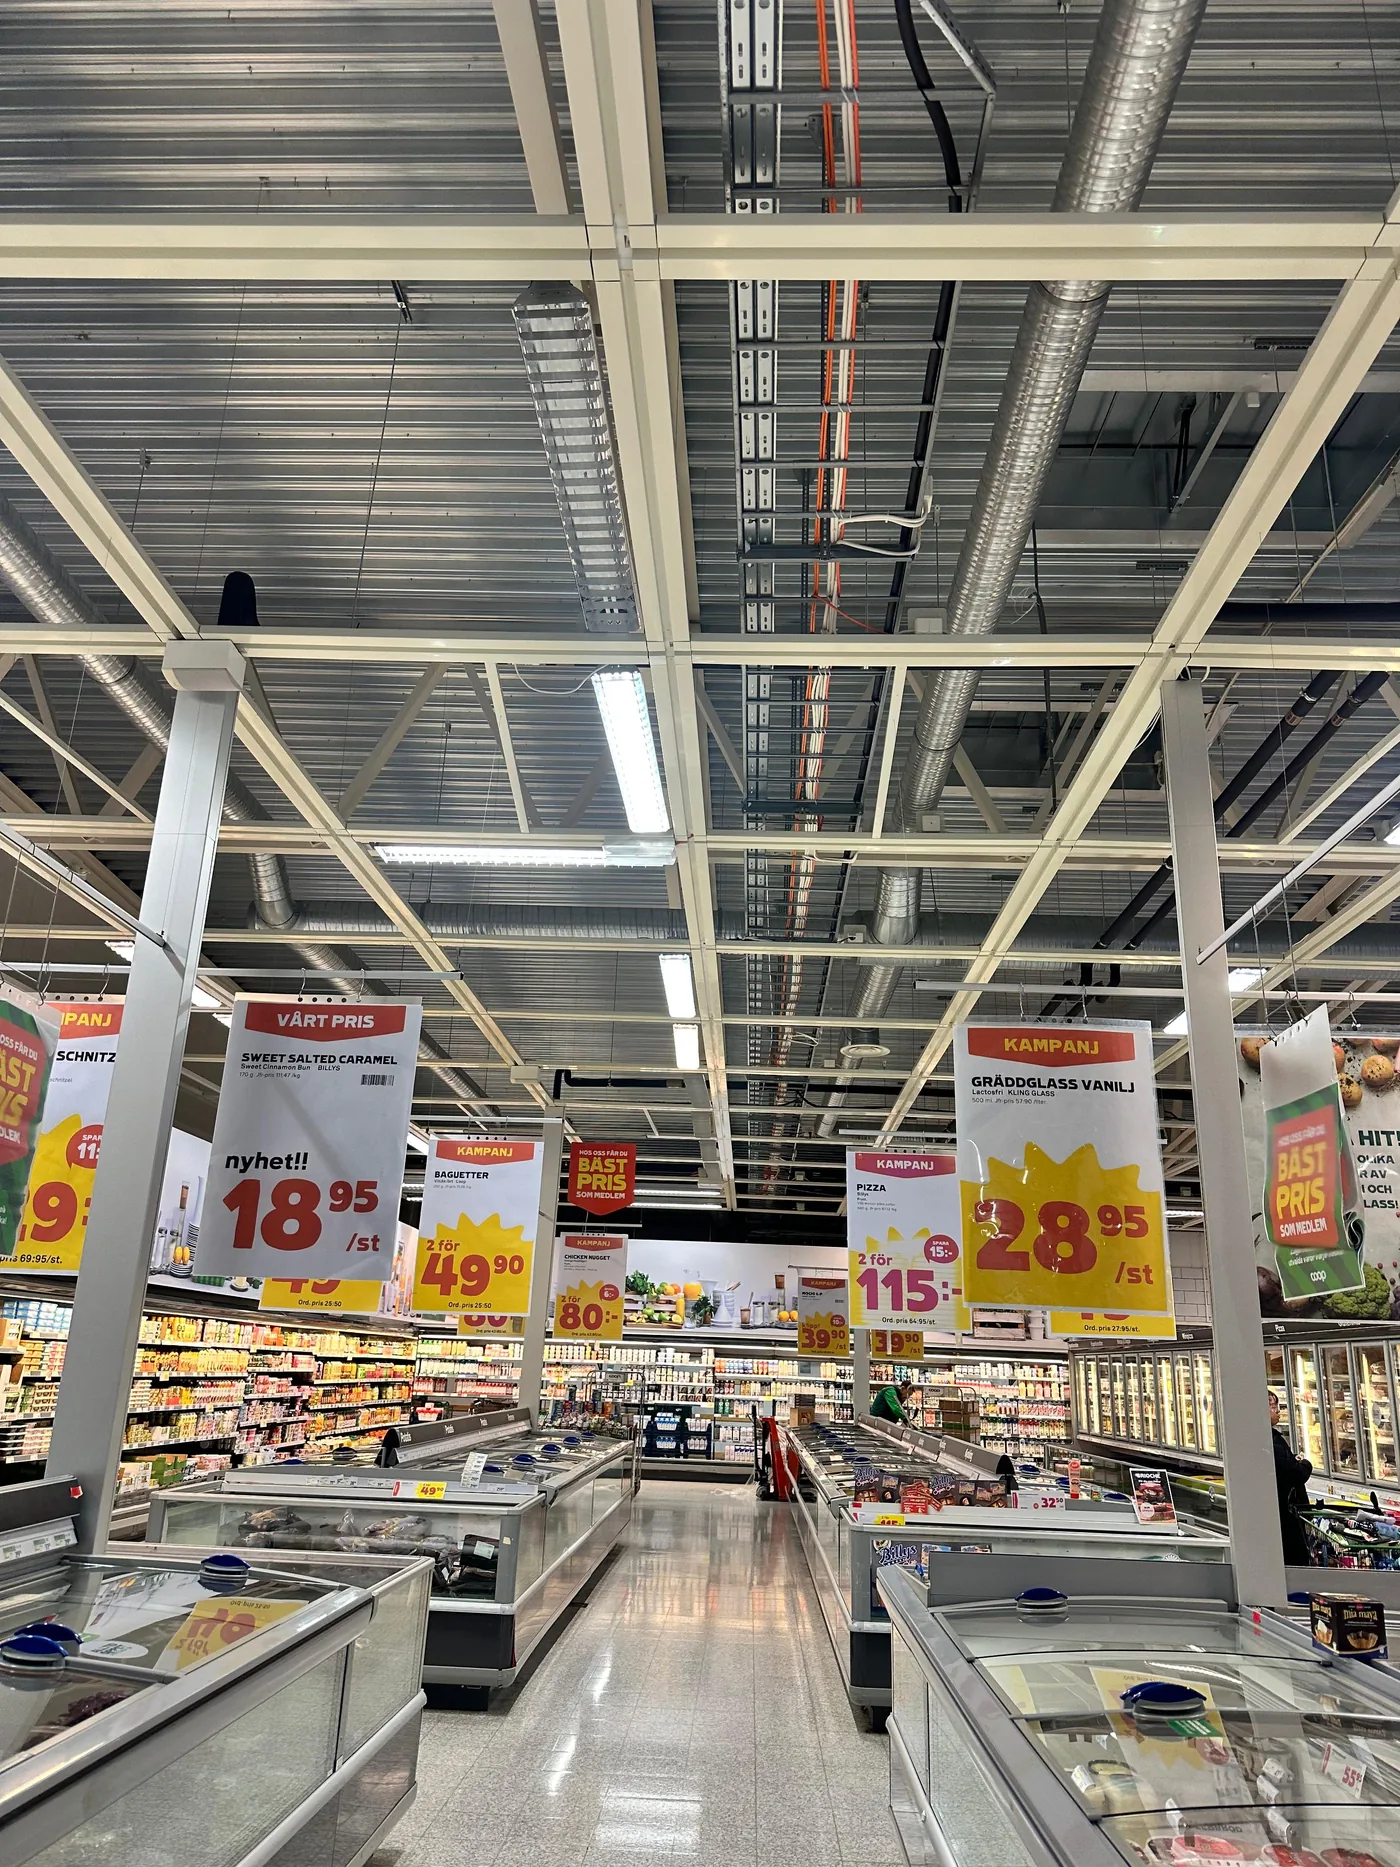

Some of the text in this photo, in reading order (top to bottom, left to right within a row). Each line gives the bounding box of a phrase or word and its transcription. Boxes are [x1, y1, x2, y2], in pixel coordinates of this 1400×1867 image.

[61, 1012, 112, 1027] PANJ
[277, 1011, 375, 1029] VÅRT PRIS
[1004, 1037, 1098, 1055] KAMPANJ
[56, 1051, 116, 1063] SCHNITZ
[241, 1053, 398, 1065] SWEET SALTED CARAMEL
[263, 1063, 297, 1071] Cinnamon
[971, 1074, 1135, 1093] GRÄDDGLASS VANILJ
[457, 1147, 513, 1157] KAMPANJ
[225, 1152, 309, 1174] nyhet!!
[578, 1157, 628, 1173] BÄST
[876, 1159, 934, 1171] KAMPANJ
[1278, 1142, 1327, 1182] BÄST
[434, 1171, 489, 1179] BAGUETTER
[1371, 1170, 1387, 1179] AV
[577, 1173, 627, 1191] PRIS
[1367, 1185, 1393, 1194] OCH
[1276, 1177, 1325, 1220] PRIS
[223, 1178, 379, 1251] 18 95
[1280, 1218, 1328, 1238] SOM MEDLEM
[346, 1233, 380, 1252] /st
[577, 1239, 611, 1247] KAMPANJ
[974, 1199, 1149, 1275] 28 95
[426, 1240, 461, 1251] 2 för
[930, 1246, 953, 1258] 15:-
[20, 1254, 63, 1264] 69:95/st.
[858, 1254, 893, 1266] 2 för
[421, 1253, 525, 1297] 49 90
[1115, 1262, 1154, 1285] /st
[1310, 1270, 1327, 1282] coop
[856, 1268, 962, 1312] 115:-
[568, 1295, 582, 1303] för
[559, 1303, 619, 1331] 80:-
[896, 1318, 908, 1326] pris
[1098, 1325, 1111, 1333] pris
[1112, 1325, 1140, 1333] 27:95/st.
[802, 1328, 846, 1349] 39 90
[905, 1333, 920, 1343] 90
[421, 1486, 436, 1495] 49
[1041, 1497, 1056, 1508] 32
[879, 1544, 917, 1563] Billys
[1344, 1608, 1378, 1622] mia maya
[1342, 1766, 1356, 1787] 55
